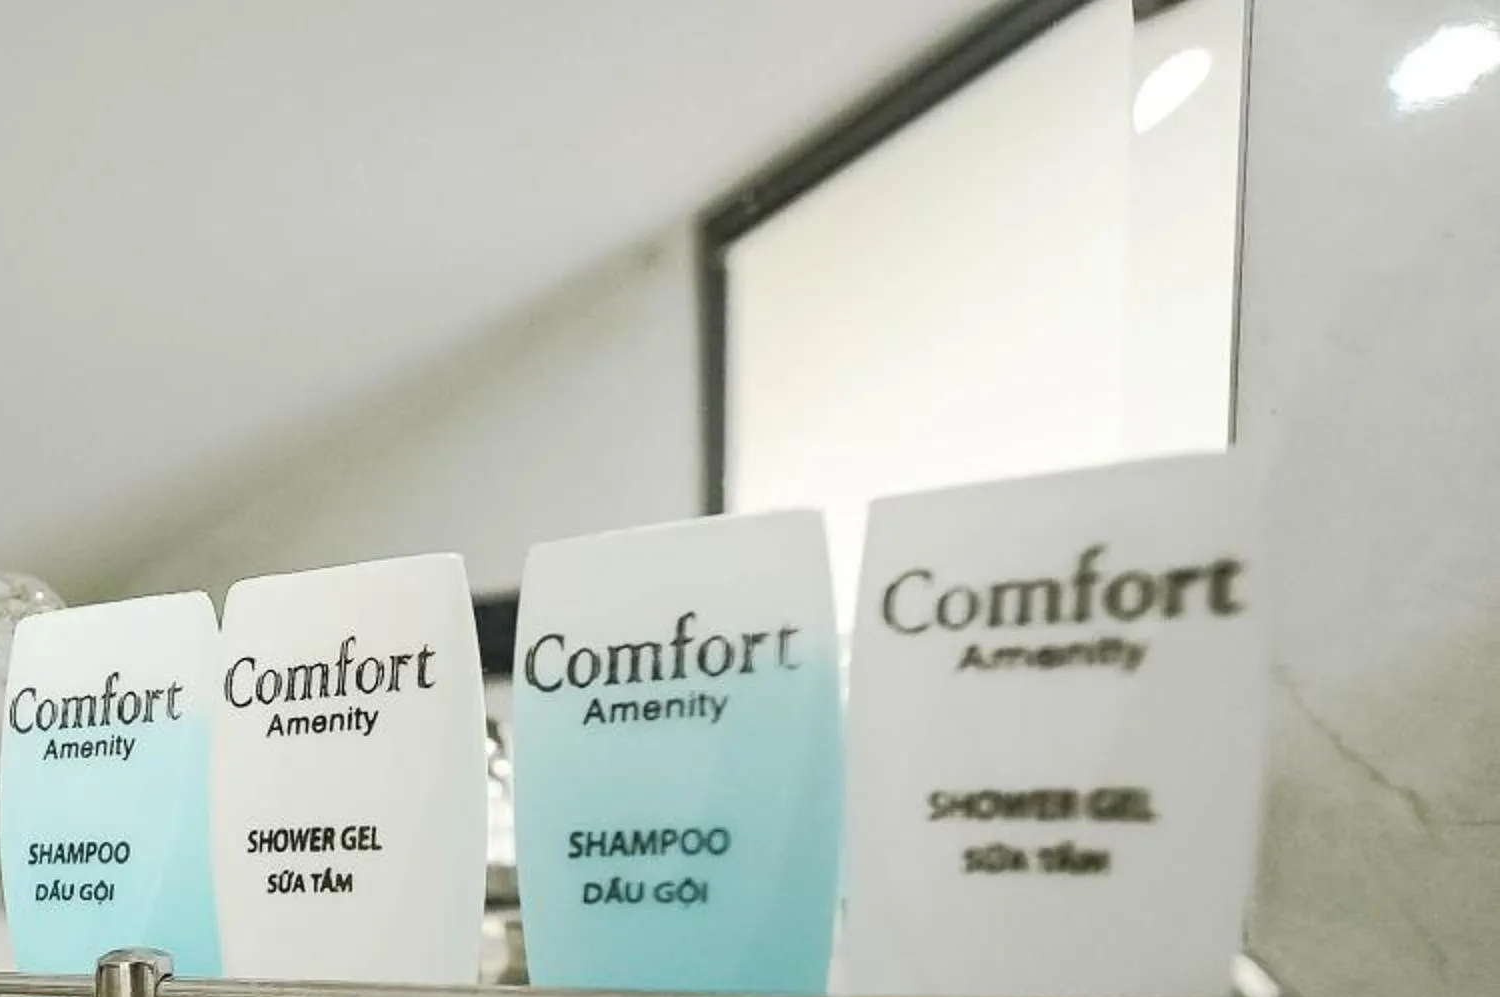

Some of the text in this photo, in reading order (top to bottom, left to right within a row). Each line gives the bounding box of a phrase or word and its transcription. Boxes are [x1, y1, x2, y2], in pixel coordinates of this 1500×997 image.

[881, 543, 1245, 635] Comfort
[524, 610, 801, 693] Comfort
[223, 634, 437, 708] Comfort
[9, 671, 184, 734] Comfort
[581, 691, 730, 726] Amenity
[265, 706, 380, 738] Amenity
[43, 735, 137, 761] Amenity
[27, 840, 131, 865] SHAMPOO
[246, 824, 383, 853] SHOWER GEL
[567, 826, 732, 859] SHAMPOO
